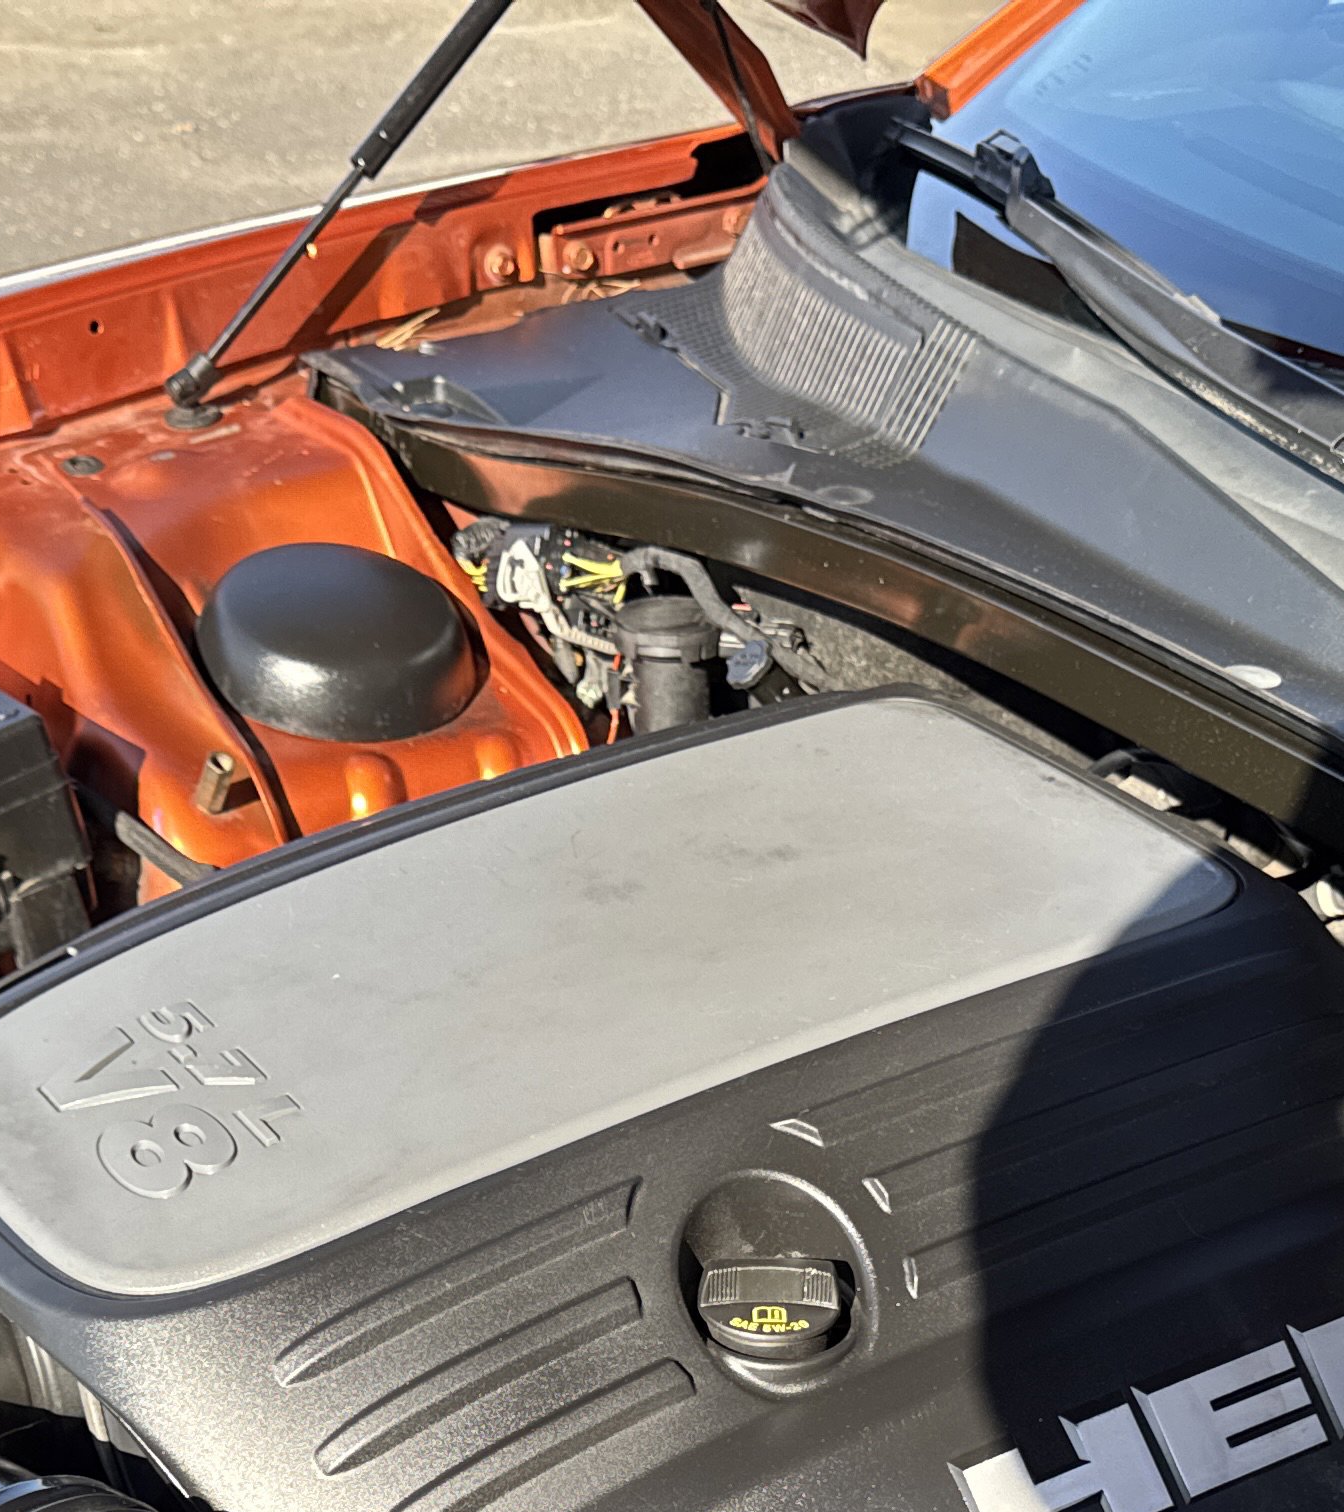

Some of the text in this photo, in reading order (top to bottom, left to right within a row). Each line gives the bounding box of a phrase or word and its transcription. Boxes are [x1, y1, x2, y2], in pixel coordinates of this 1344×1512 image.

[37, 1026, 238, 1200] V8
[729, 1317, 810, 1333] SAE 5W-20
